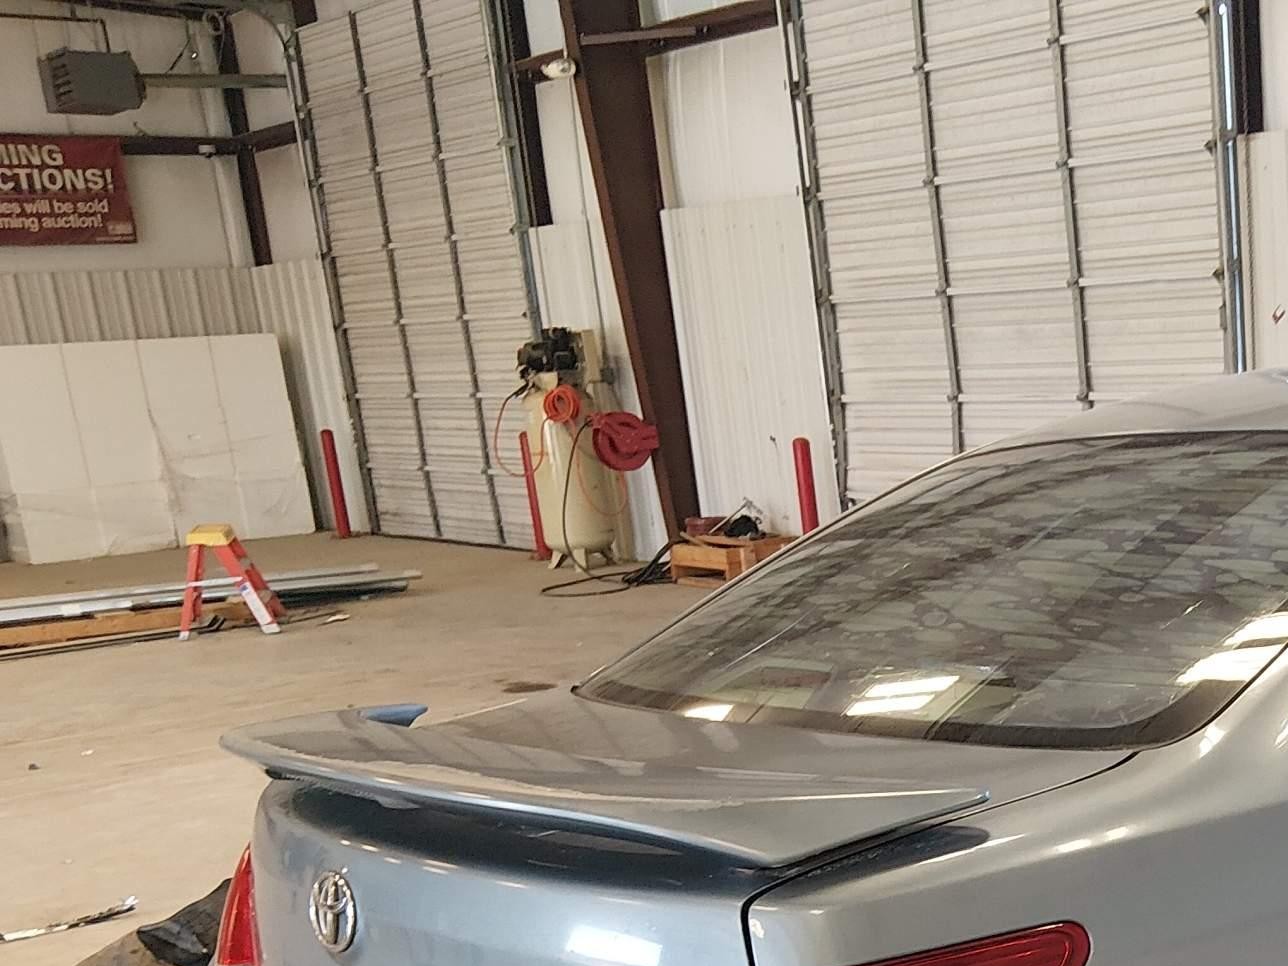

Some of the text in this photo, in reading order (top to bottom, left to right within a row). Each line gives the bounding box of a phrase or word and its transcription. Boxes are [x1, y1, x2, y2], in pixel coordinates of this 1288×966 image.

[23, 199, 51, 214] will
[53, 199, 75, 214] be
[76, 199, 109, 213] sold
[41, 213, 104, 228] auction!
